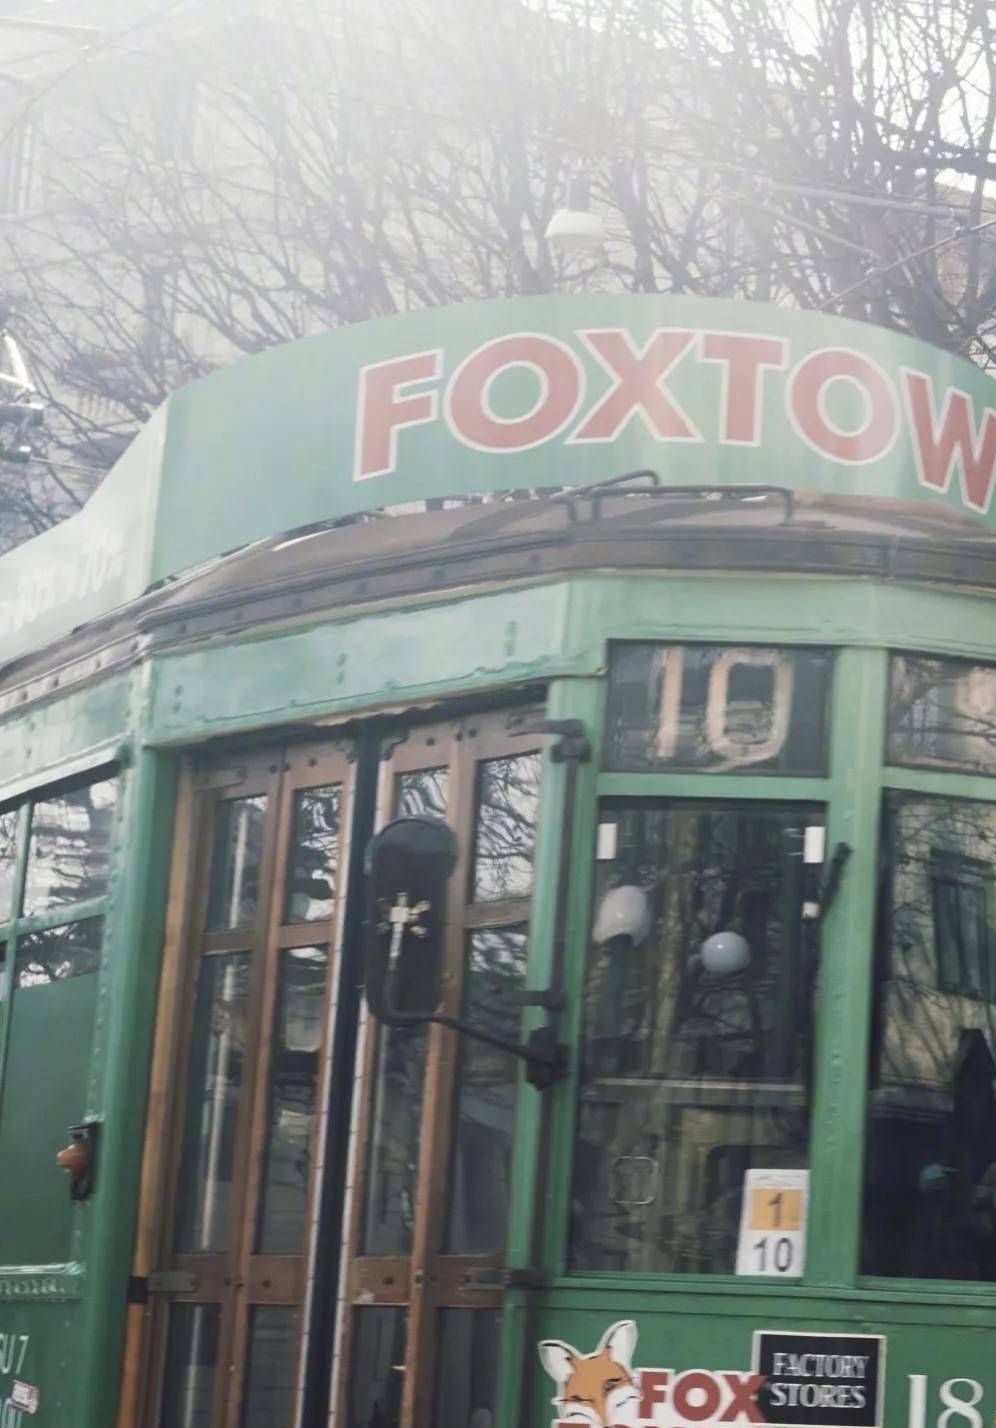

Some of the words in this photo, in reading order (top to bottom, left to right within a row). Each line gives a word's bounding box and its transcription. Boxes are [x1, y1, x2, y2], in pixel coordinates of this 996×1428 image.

[658, 647, 793, 770] 10
[768, 1192, 784, 1228] 1
[753, 1236, 793, 1272] 10
[772, 1352, 870, 1379] FACTORY
[638, 1370, 768, 1424] FOX
[769, 1382, 867, 1409] STORES
